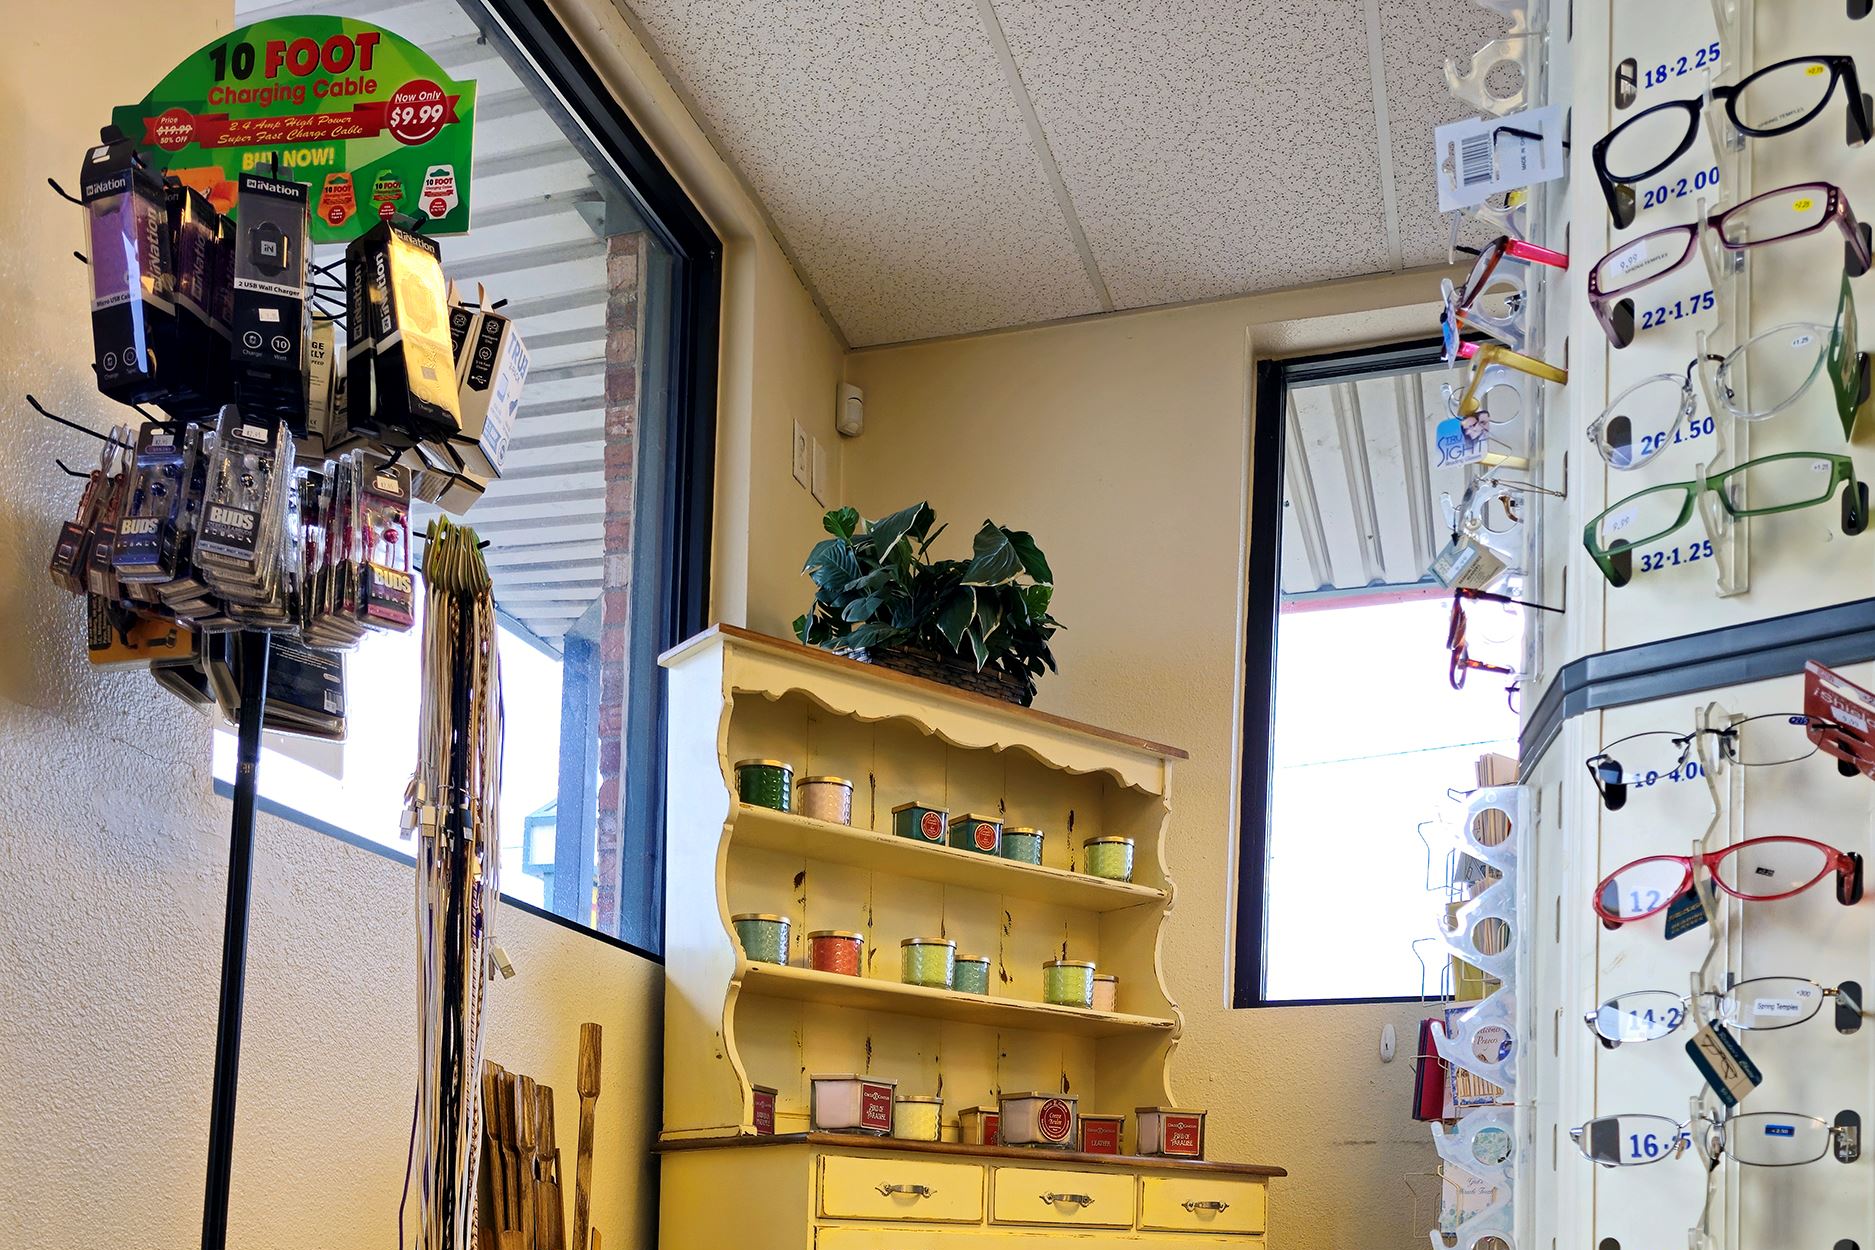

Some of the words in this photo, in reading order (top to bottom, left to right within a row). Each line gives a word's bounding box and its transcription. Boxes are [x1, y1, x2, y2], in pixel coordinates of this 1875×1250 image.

[208, 42, 256, 81] 10
[265, 32, 380, 79] FOOT
[208, 83, 306, 108] Charging
[313, 76, 377, 98] Cable
[395, 93, 416, 103] Now
[418, 91, 441, 101] Only
[160, 116, 178, 124] Price
[253, 119, 281, 130] Amp
[284, 116, 313, 128] High
[318, 115, 351, 125] Power
[390, 104, 443, 127] $9.99
[217, 134, 251, 144] Super
[256, 132, 283, 143] Fast
[286, 129, 326, 141] Charge
[331, 126, 363, 137] Cable
[283, 148, 334, 168] NOW!
[94, 178, 126, 193] iNation
[257, 180, 299, 197] iNation
[259, 284, 273, 292] Wall
[273, 287, 300, 296] Charger
[276, 340, 287, 349] 10
[1437, 437, 1483, 467] SIGHT
[210, 505, 254, 530] BUDS
[121, 518, 160, 535] BUDS
[373, 567, 412, 594] BUDS
[1757, 1002, 1775, 1012] Spring
[1777, 1002, 1799, 1012] Temples
